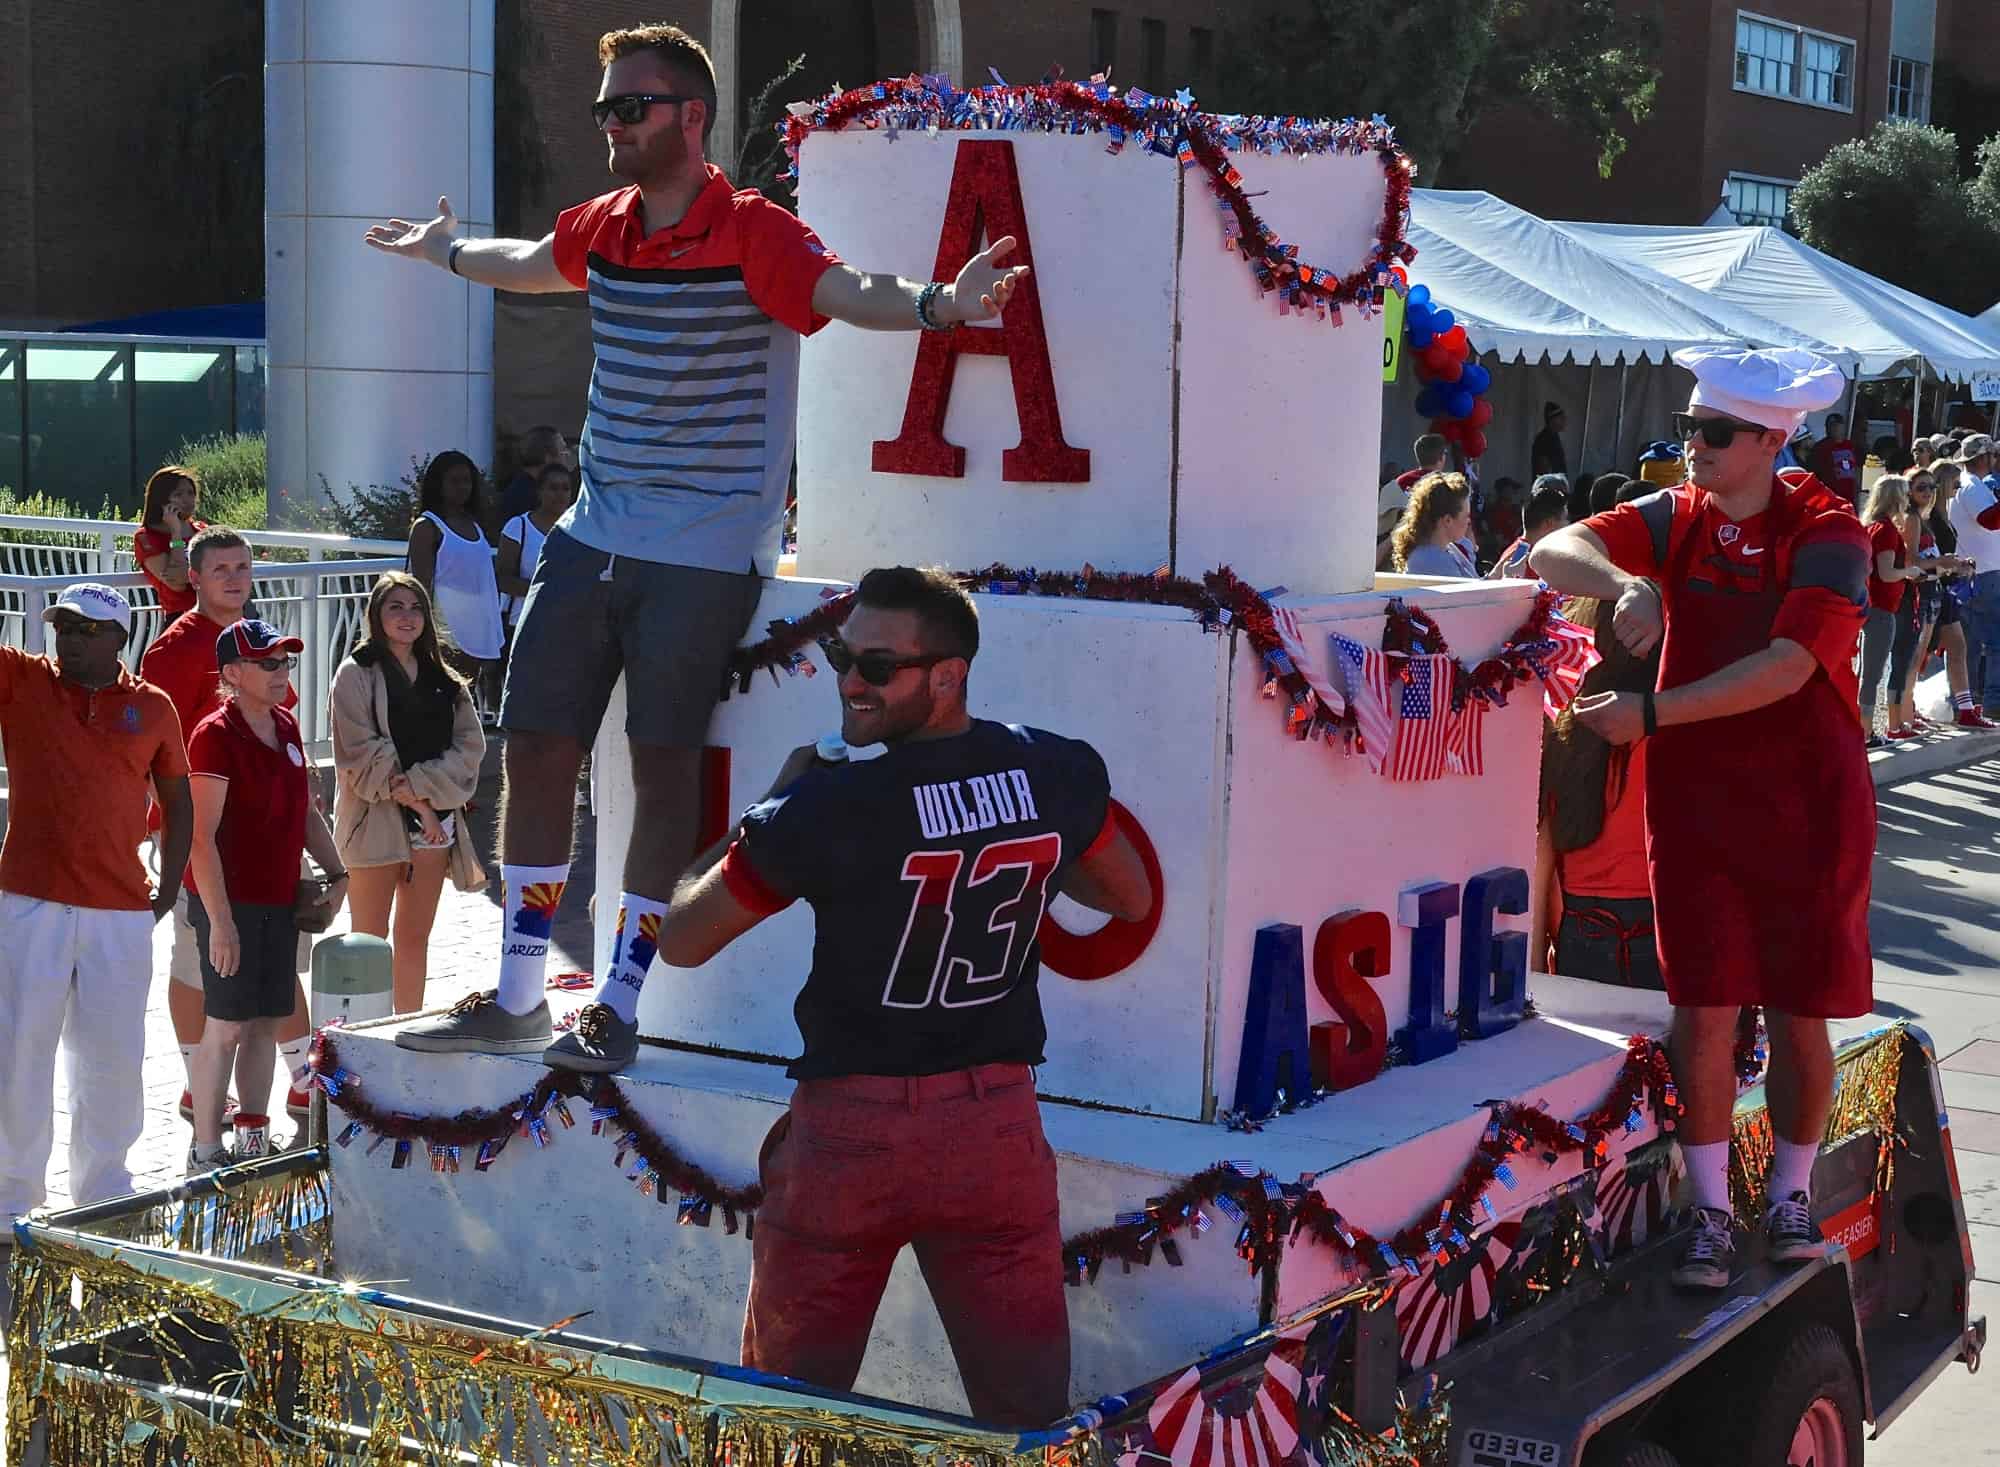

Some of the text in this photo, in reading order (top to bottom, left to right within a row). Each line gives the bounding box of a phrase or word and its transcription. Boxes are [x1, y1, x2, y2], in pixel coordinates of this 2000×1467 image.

[872, 139, 1091, 483] A
[81, 588, 118, 608] PING
[912, 768, 1039, 839] WILBUR
[882, 831, 1062, 1009] 13
